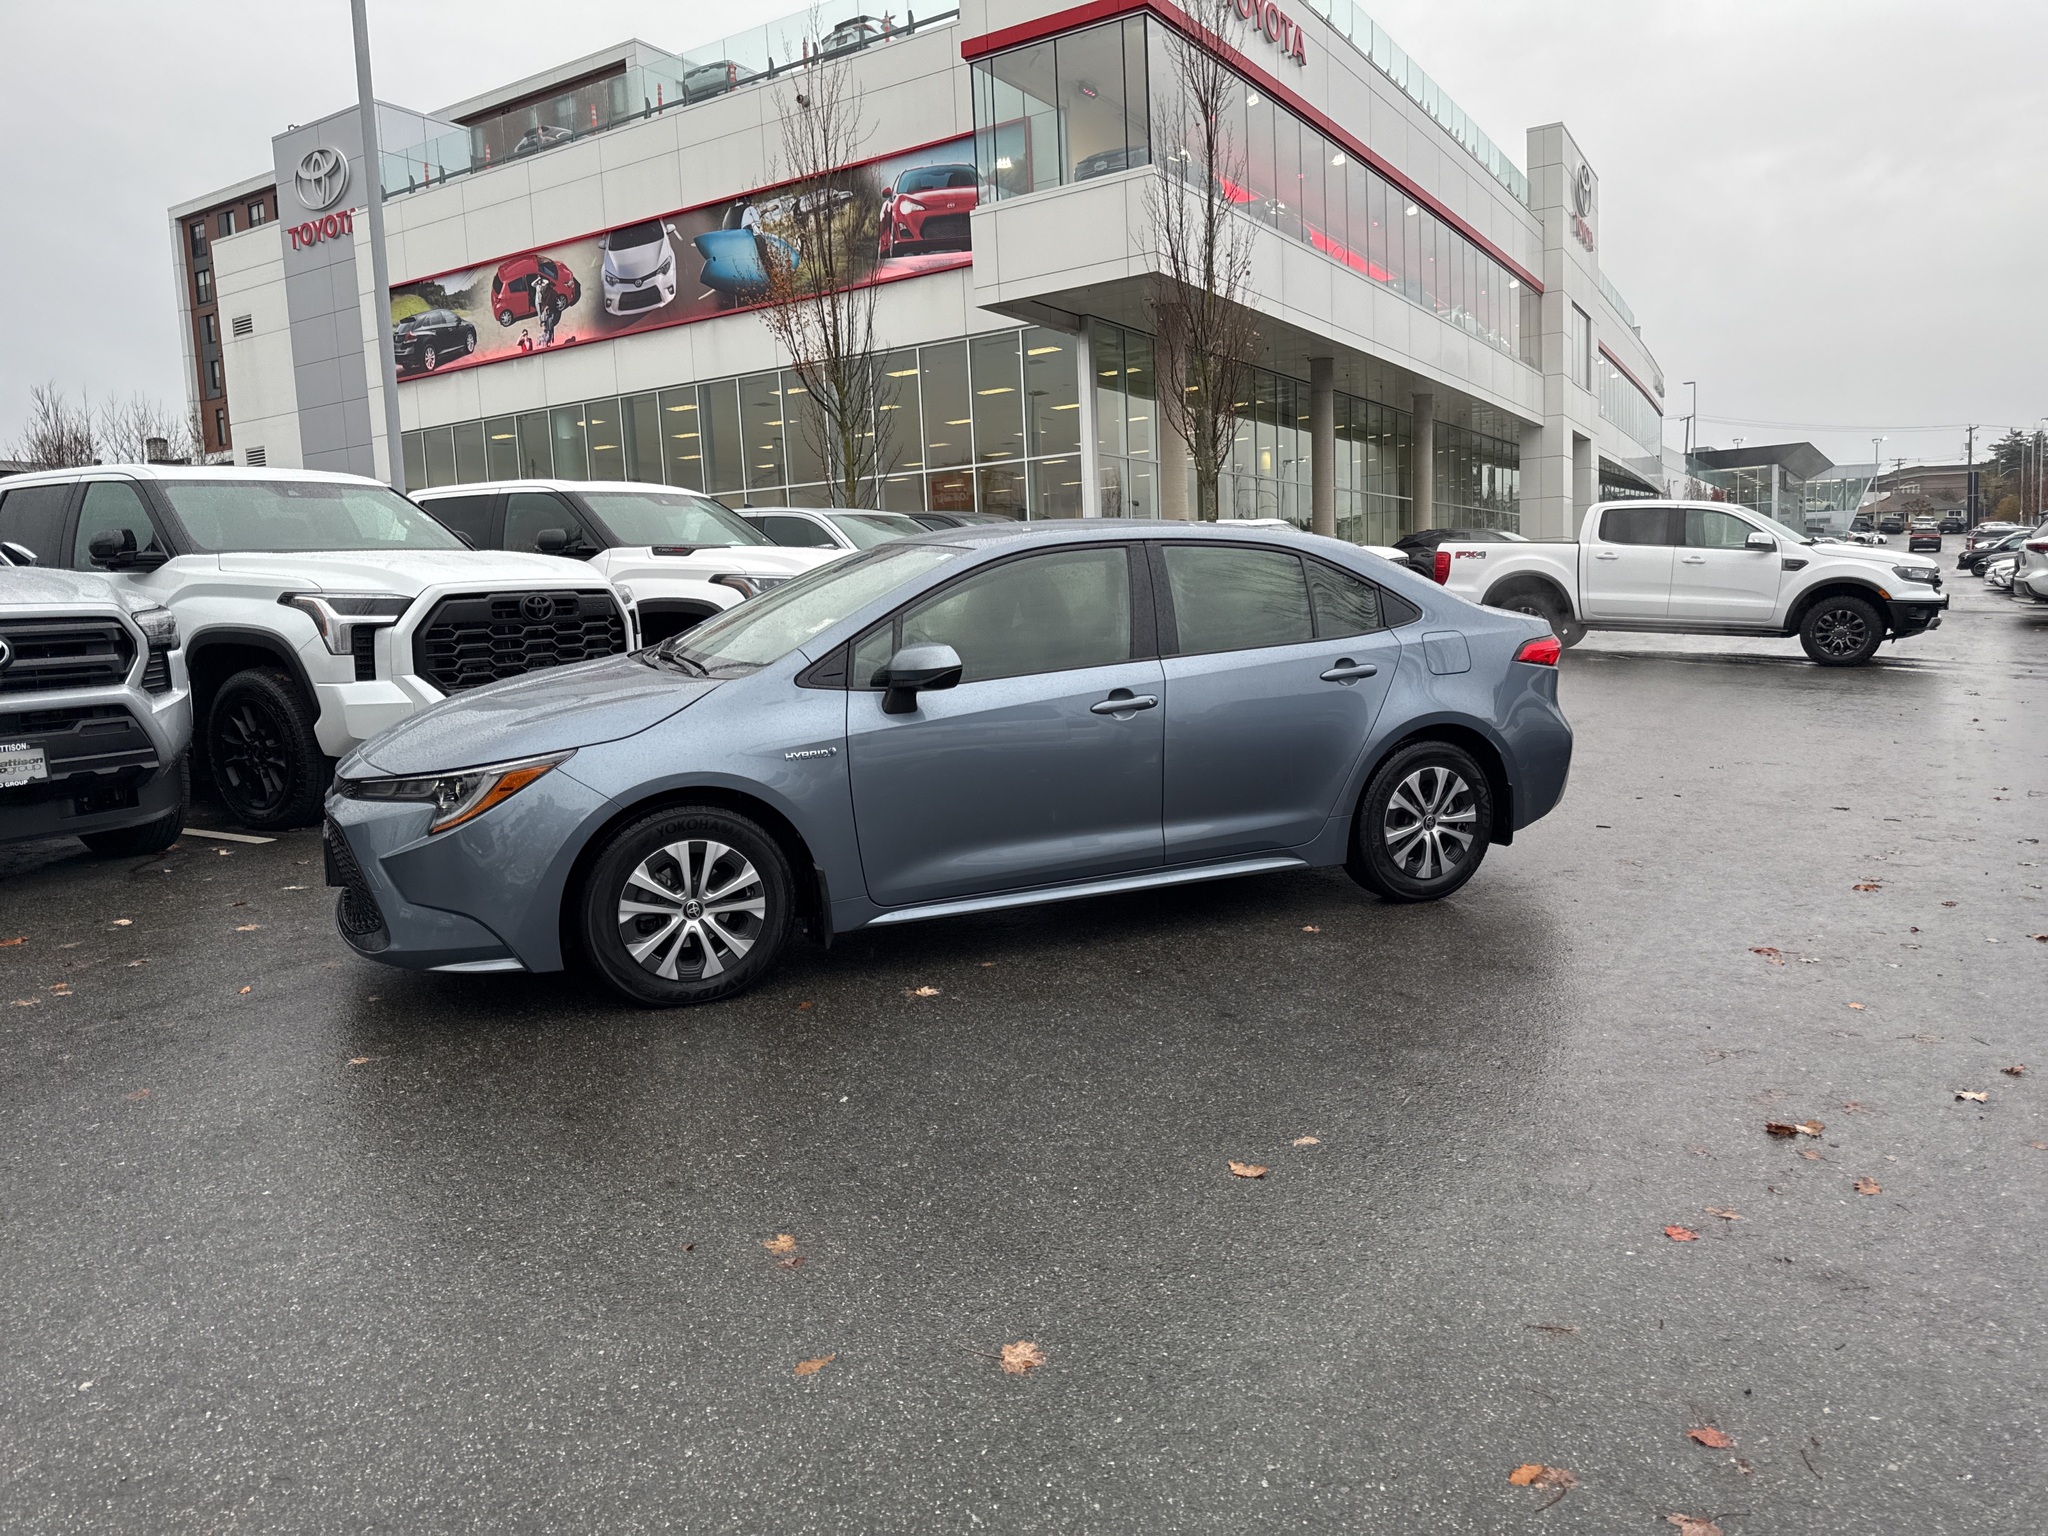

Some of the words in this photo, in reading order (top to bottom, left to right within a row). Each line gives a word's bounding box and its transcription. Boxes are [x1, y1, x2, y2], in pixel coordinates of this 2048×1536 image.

[785, 749, 829, 761] HYBRID
[4, 780, 28, 788] GROUP
[656, 818, 743, 839] YOKOHAMA
